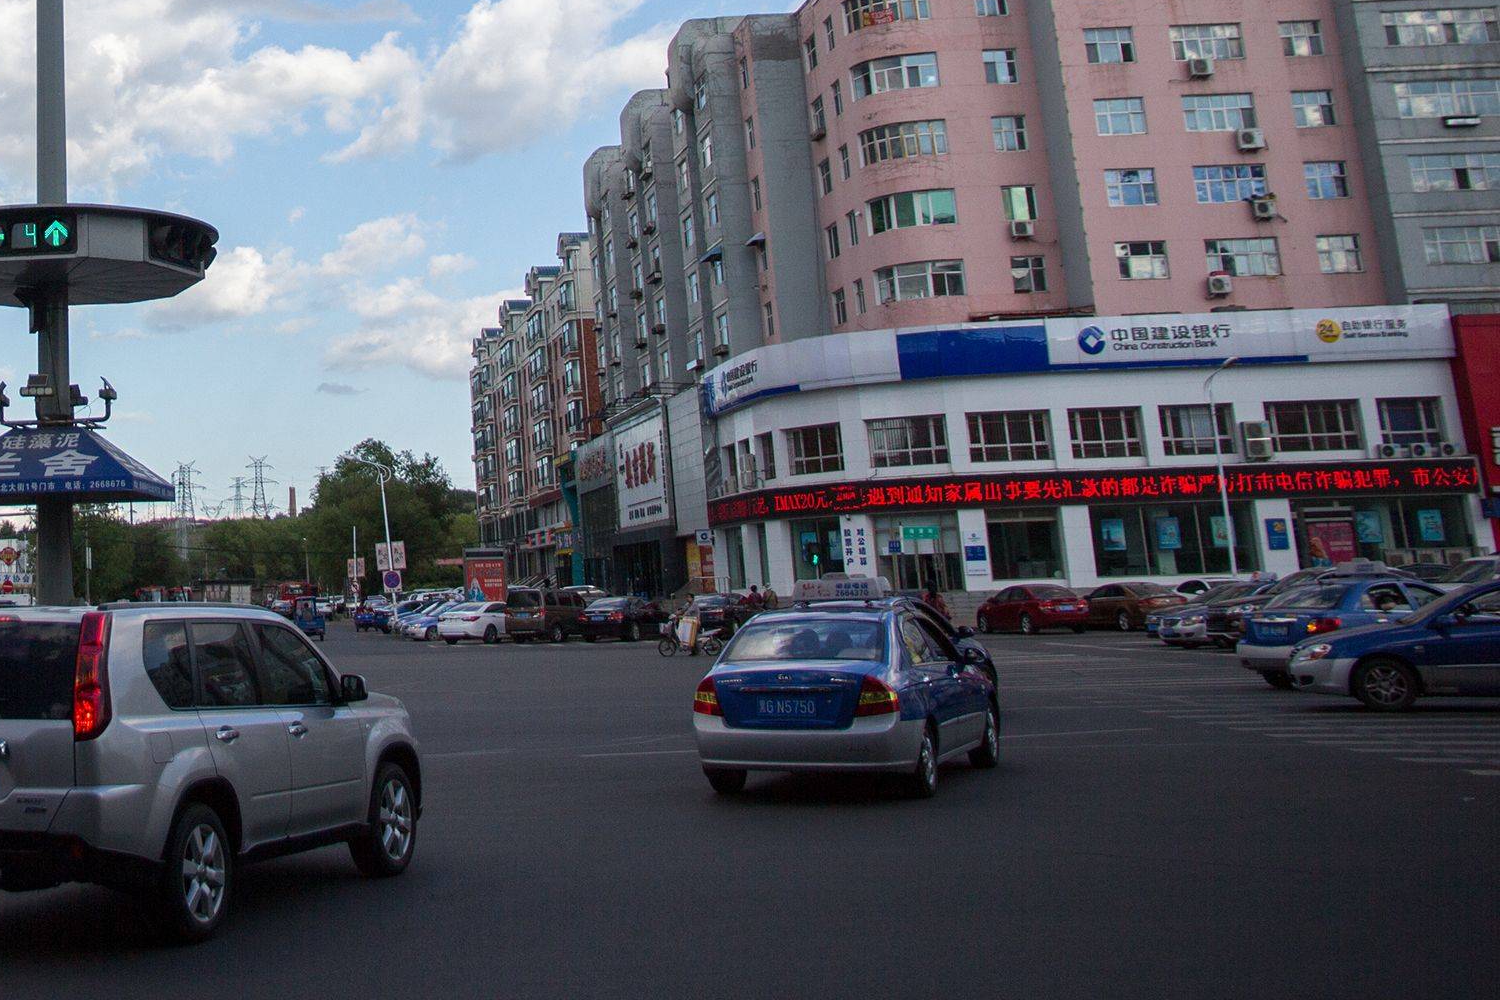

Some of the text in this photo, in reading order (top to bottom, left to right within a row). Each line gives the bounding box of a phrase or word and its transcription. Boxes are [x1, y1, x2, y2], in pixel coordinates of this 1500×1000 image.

[25, 223, 36, 246] 4
[1341, 319, 1407, 331] 自助银行服务
[1111, 324, 1231, 341] 中国建设银行
[1113, 339, 1217, 351] China Construction Bank
[2, 433, 80, 450] 硅藻泥
[90, 479, 127, 489] 2668676
